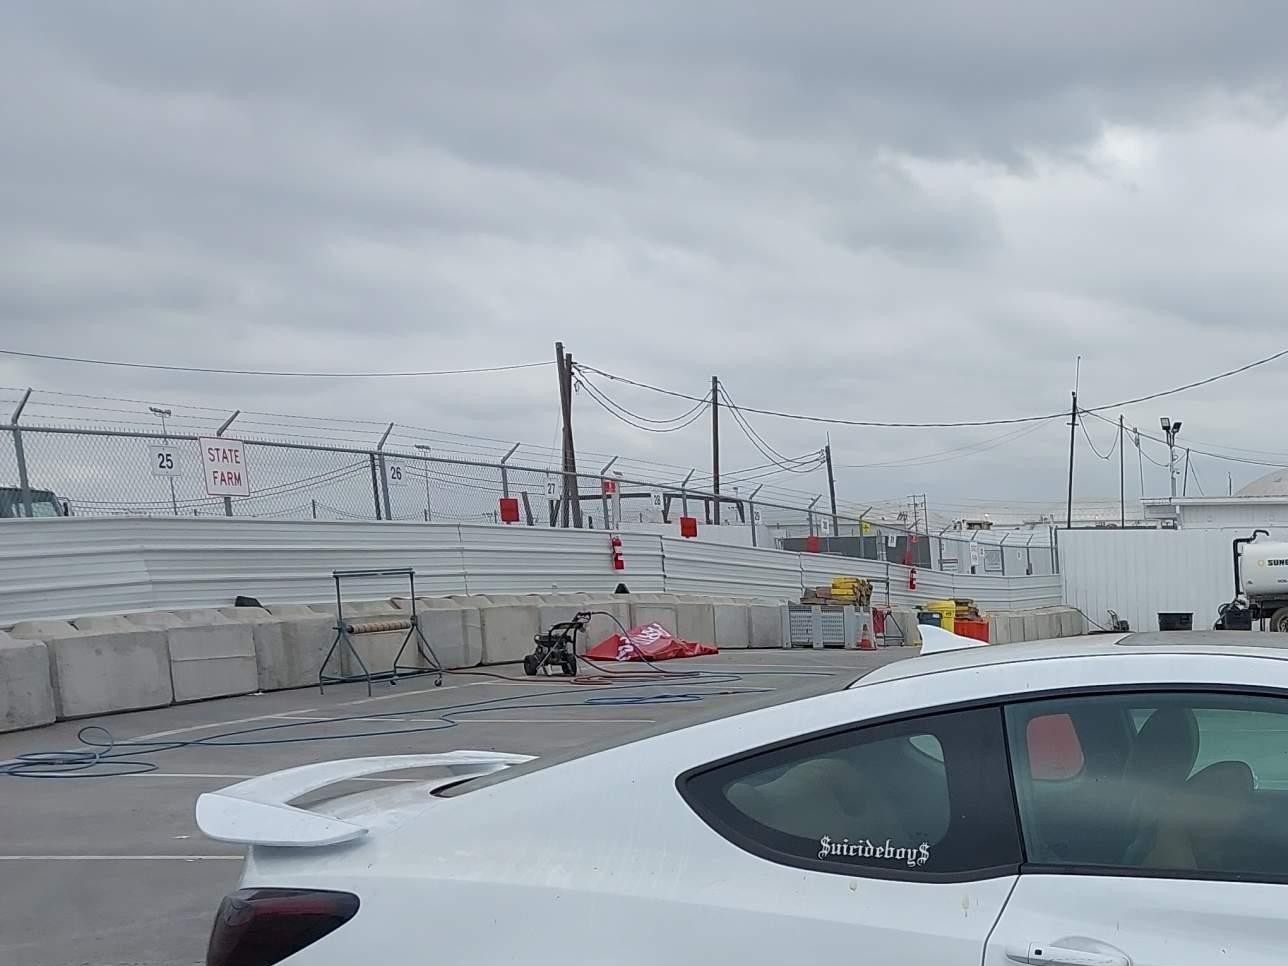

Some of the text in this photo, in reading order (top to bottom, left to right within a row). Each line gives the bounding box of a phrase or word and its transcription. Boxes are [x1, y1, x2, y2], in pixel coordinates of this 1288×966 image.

[157, 453, 174, 470] 25
[207, 447, 241, 464] STATE
[212, 470, 242, 486] FARM
[390, 466, 402, 480] 26
[547, 482, 556, 495] 27
[817, 834, 931, 868] $uicideboy$
